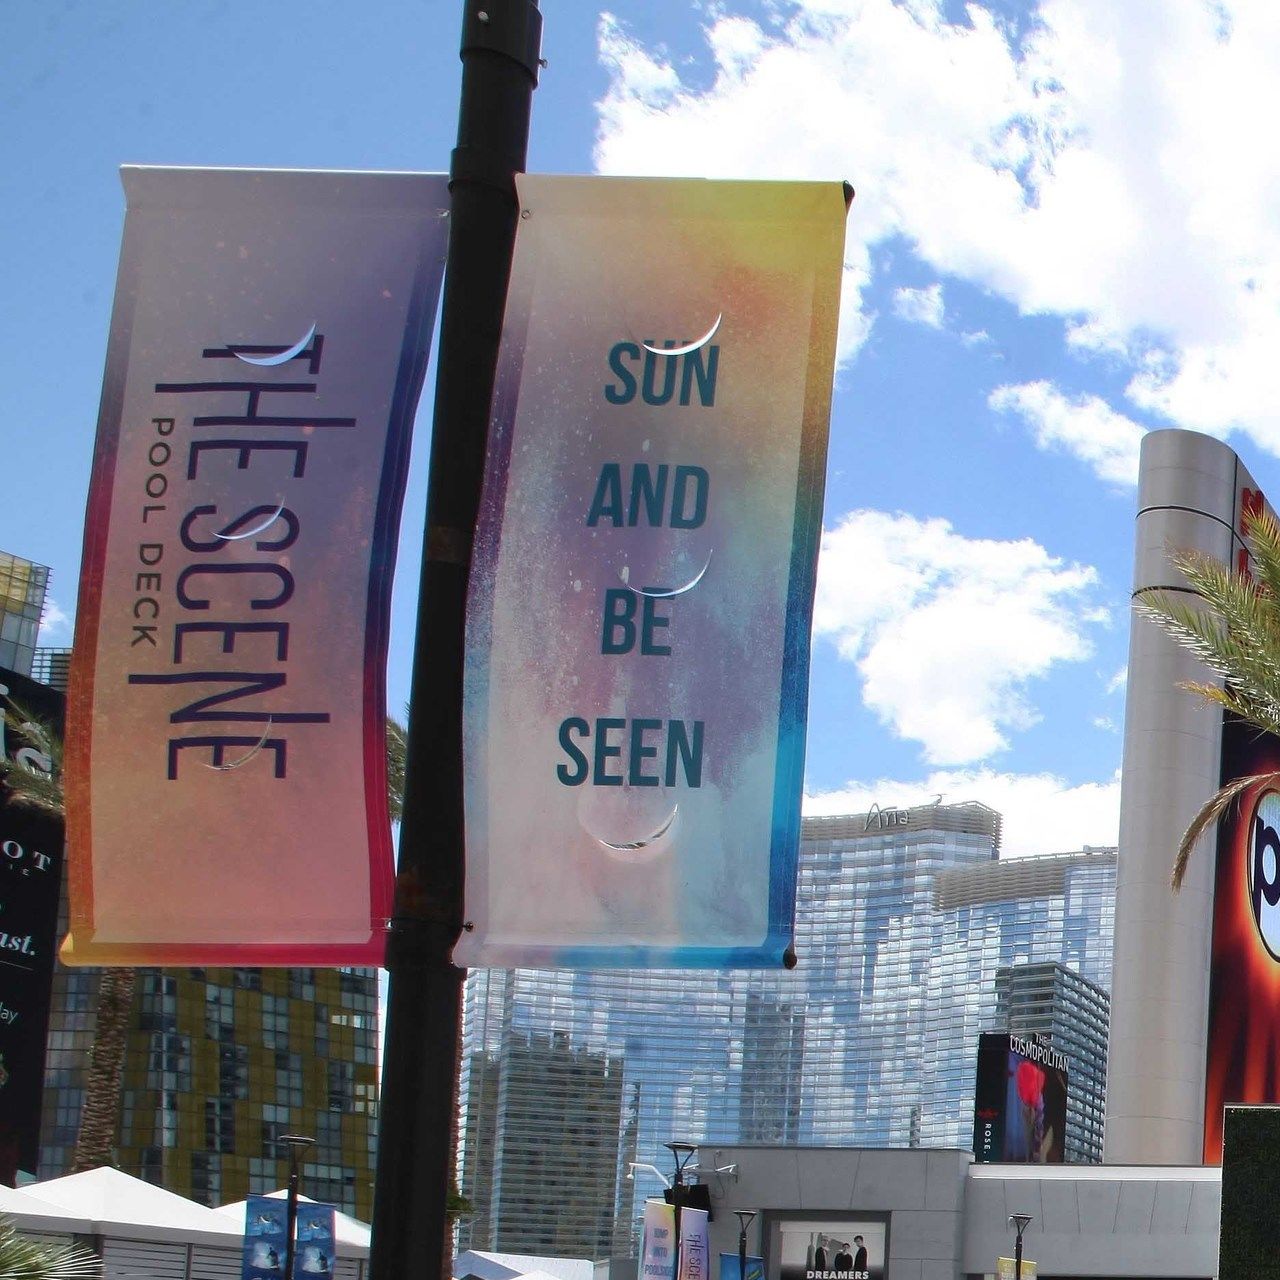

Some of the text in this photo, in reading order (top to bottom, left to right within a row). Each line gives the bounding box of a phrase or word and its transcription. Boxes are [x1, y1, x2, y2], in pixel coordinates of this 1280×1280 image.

[604, 339, 721, 408] SUN
[586, 462, 711, 530] AND
[128, 333, 356, 781] THE SCENE
[131, 417, 176, 648] POOL DECK
[600, 586, 674, 657] BE
[556, 716, 706, 789] SEEN
[864, 802, 909, 832] Aria
[1010, 1035, 1070, 1073] COSMOPOLITAN
[806, 1270, 869, 1280] DREAMERS
